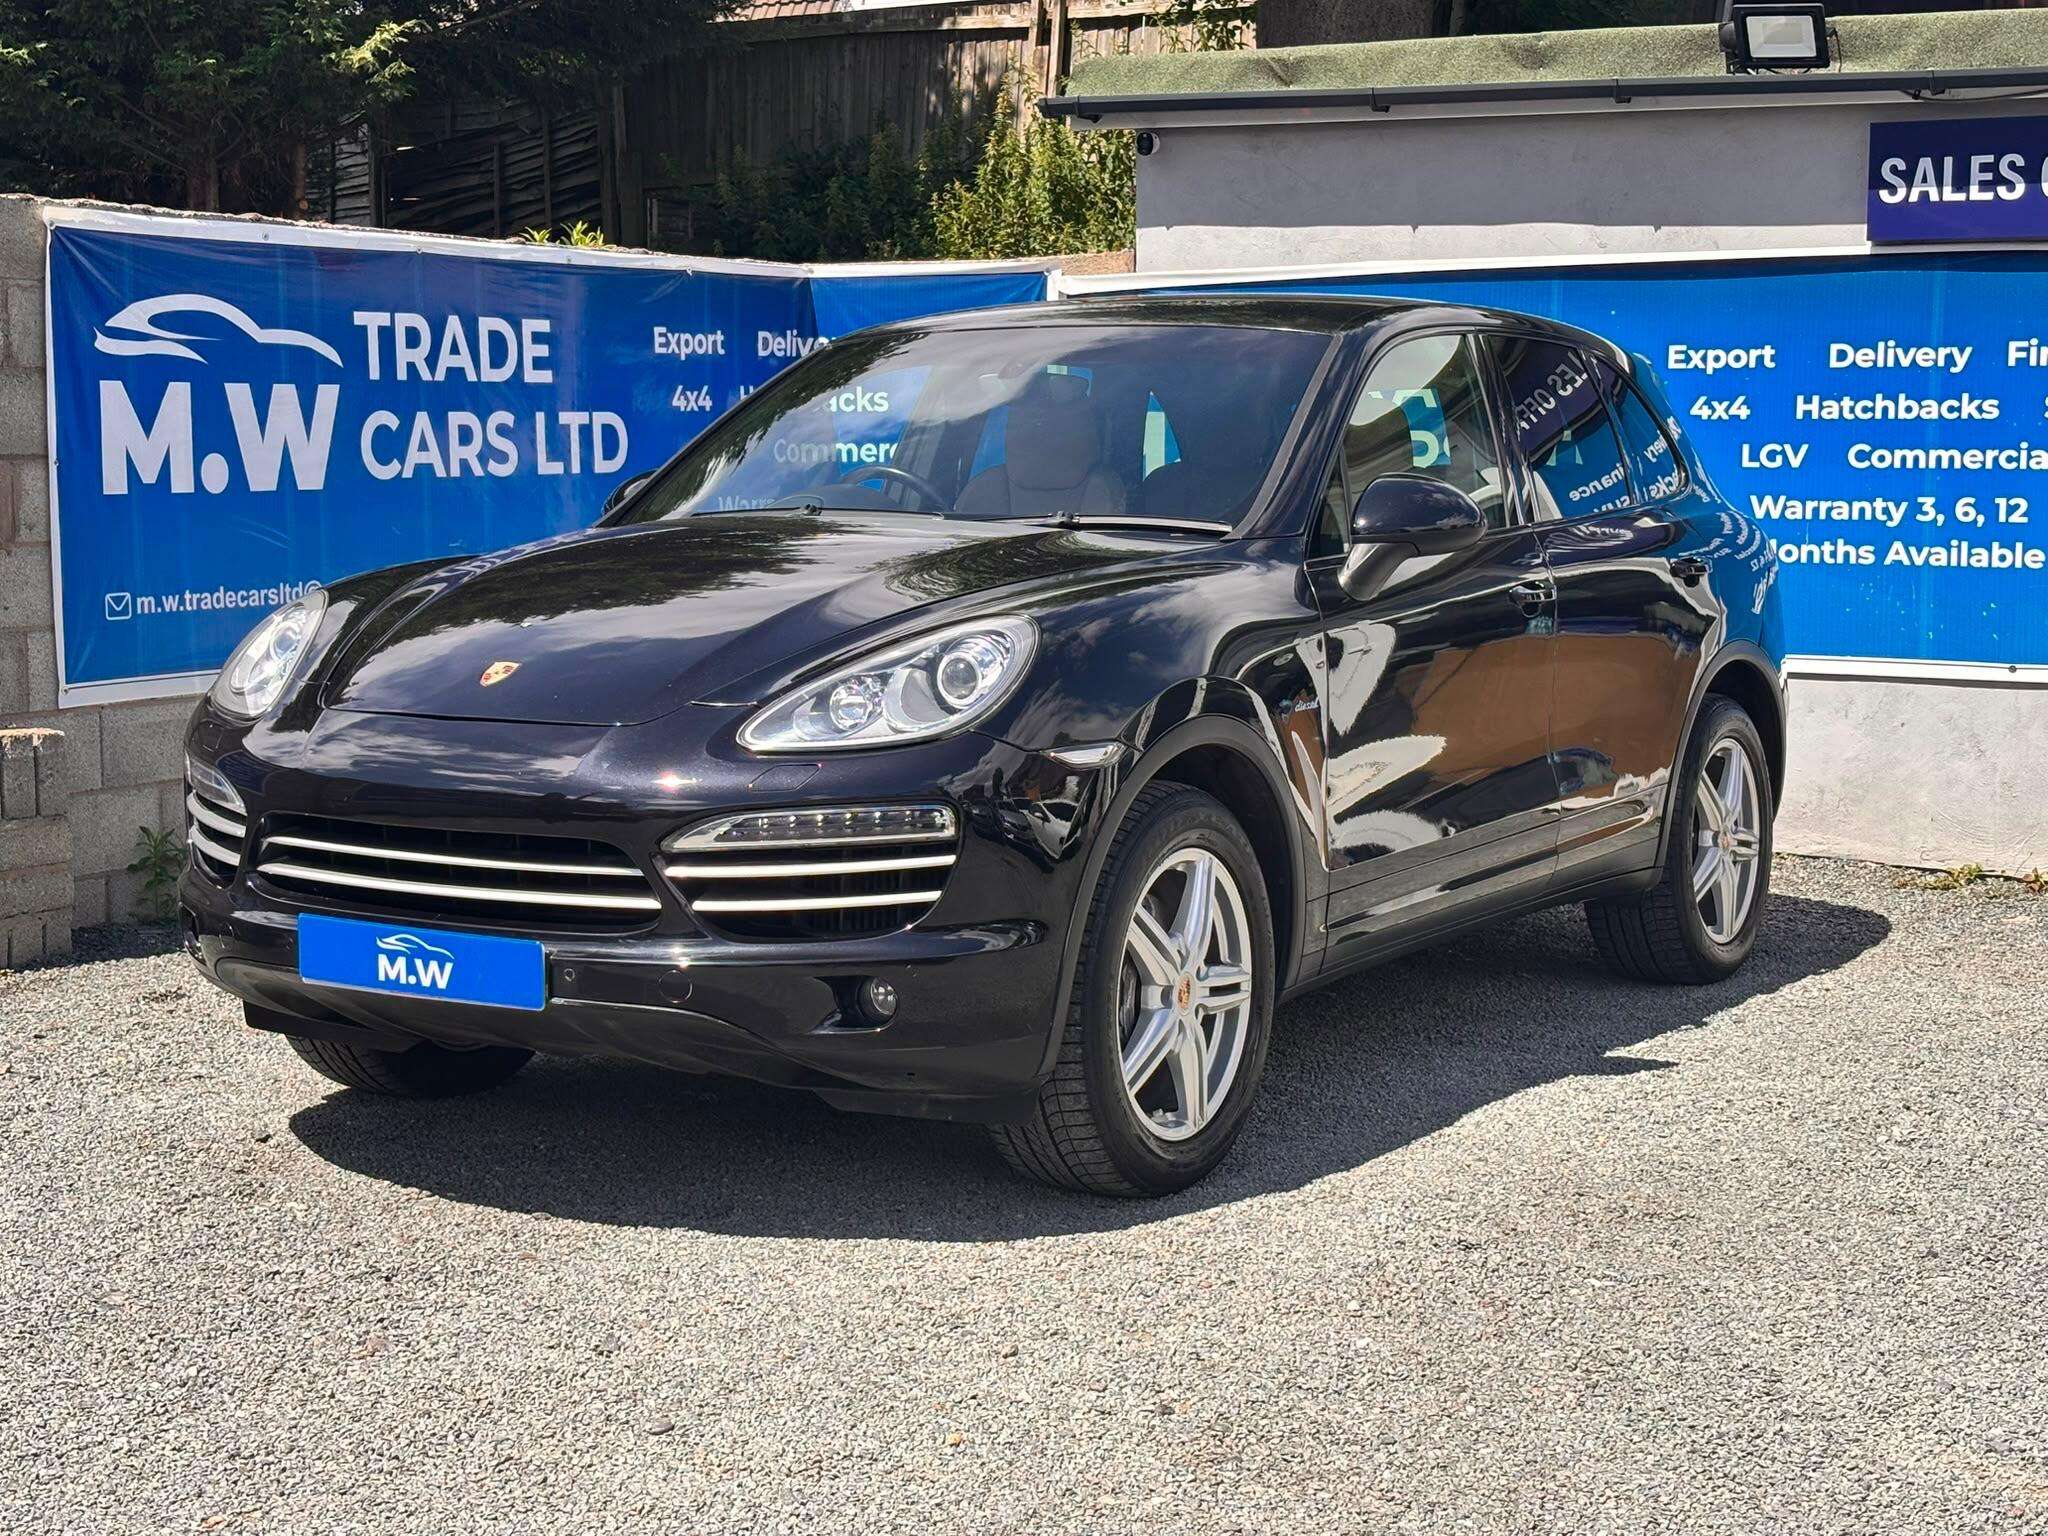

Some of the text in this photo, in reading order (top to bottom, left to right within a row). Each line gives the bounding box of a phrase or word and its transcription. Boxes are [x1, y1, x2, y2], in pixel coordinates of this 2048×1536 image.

[1878, 153, 2026, 204] SALES
[353, 310, 553, 383] TRADE
[653, 326, 837, 360] Export Delive
[1667, 344, 1776, 375] Export
[1828, 339, 1973, 374] Delivery
[671, 385, 713, 412] 4x4
[1689, 392, 2000, 420] 4x4 Hatchbacks
[100, 379, 341, 496] M.W
[360, 410, 630, 481] CARS LTD
[1741, 441, 2048, 470] LGV Commercia
[1749, 494, 1909, 528] Warranty
[1915, 496, 1946, 527] 3,
[1955, 496, 1986, 528] 6,
[1994, 497, 2029, 524] 12
[1883, 539, 2047, 570] Available
[377, 953, 454, 990] M.W
